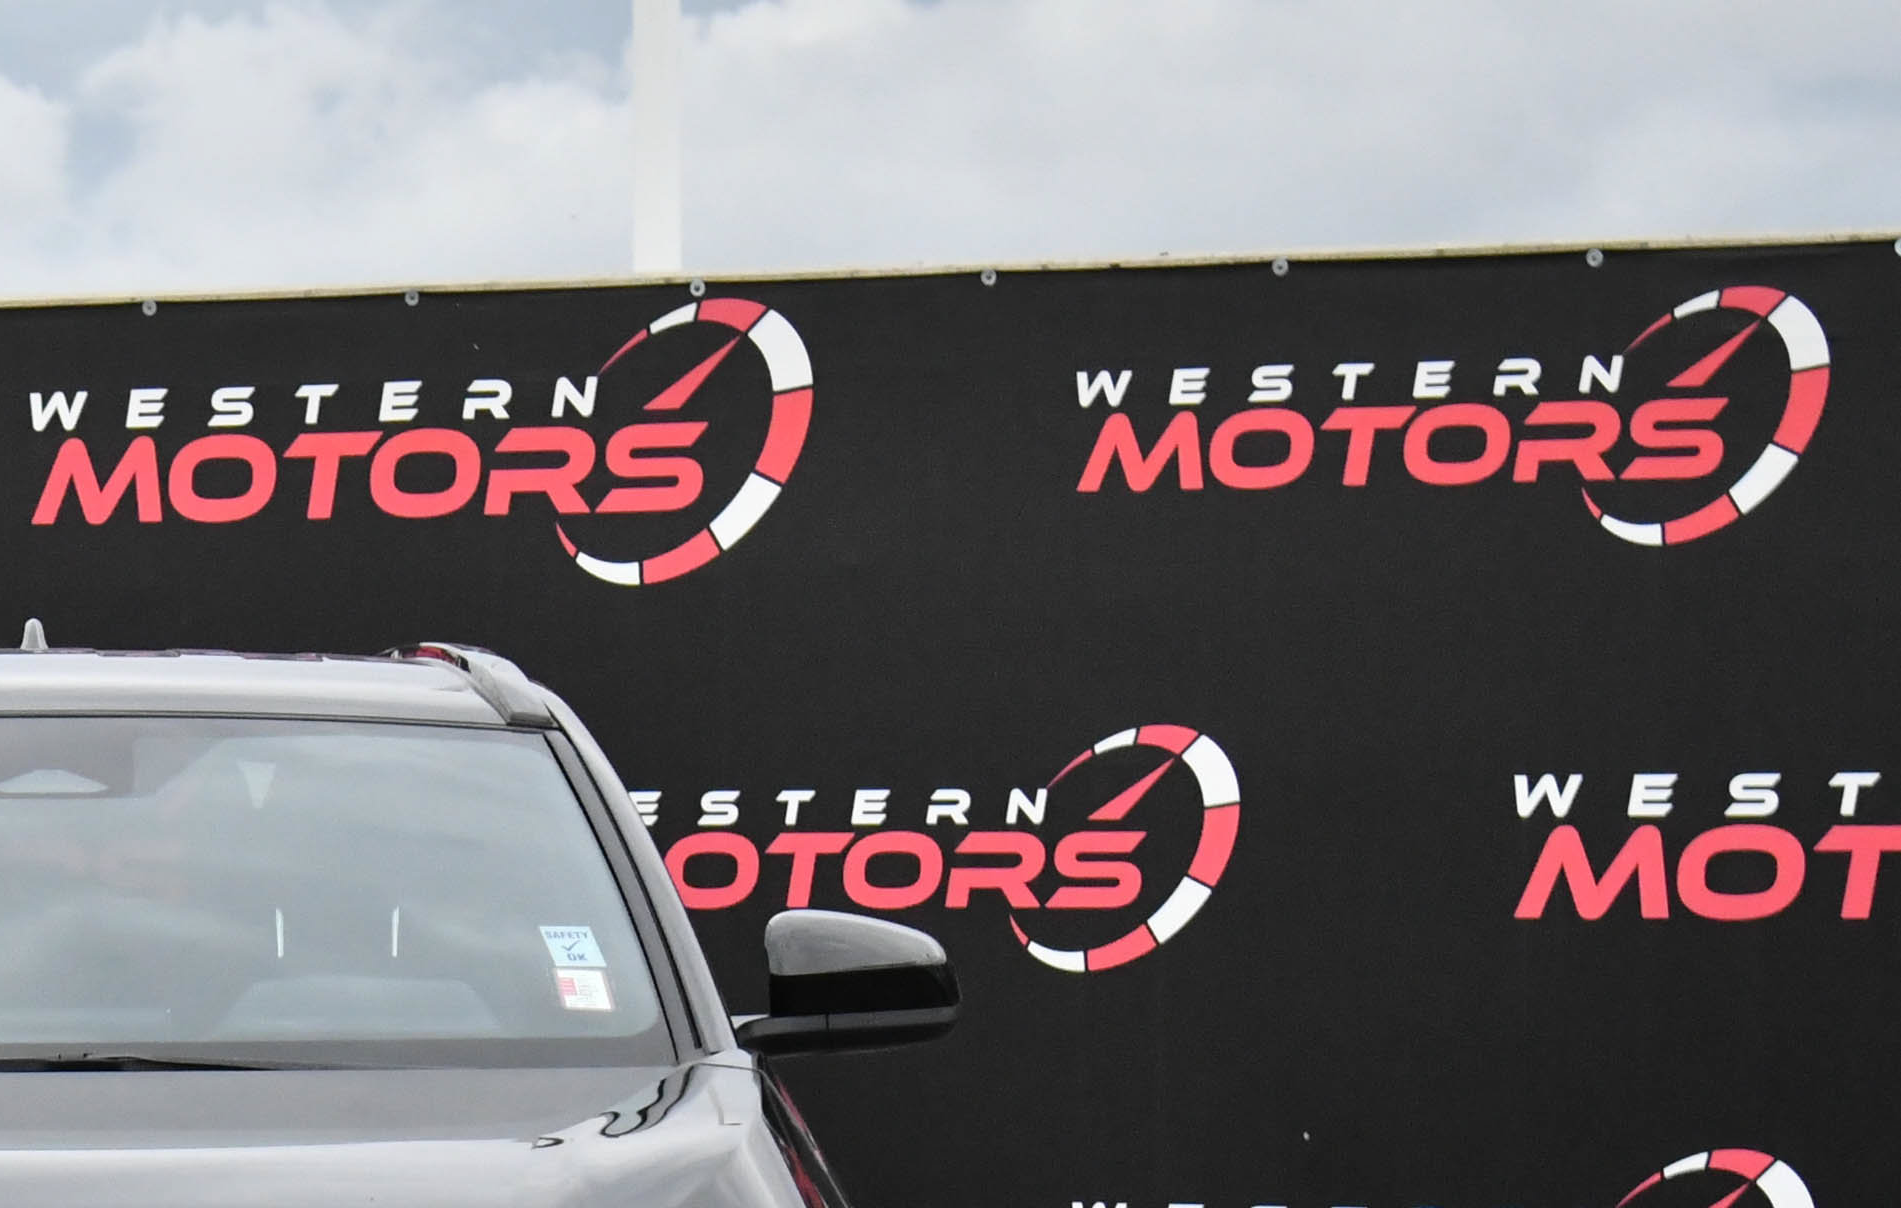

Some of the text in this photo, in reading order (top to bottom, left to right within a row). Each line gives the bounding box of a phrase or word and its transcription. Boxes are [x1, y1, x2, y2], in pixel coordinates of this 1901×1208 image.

[30, 376, 599, 432] WESTERN
[1076, 355, 1624, 408] WESTERN
[31, 422, 709, 526] MOTORS
[1077, 398, 1729, 494] MOTORS
[1514, 773, 1881, 818] WEST
